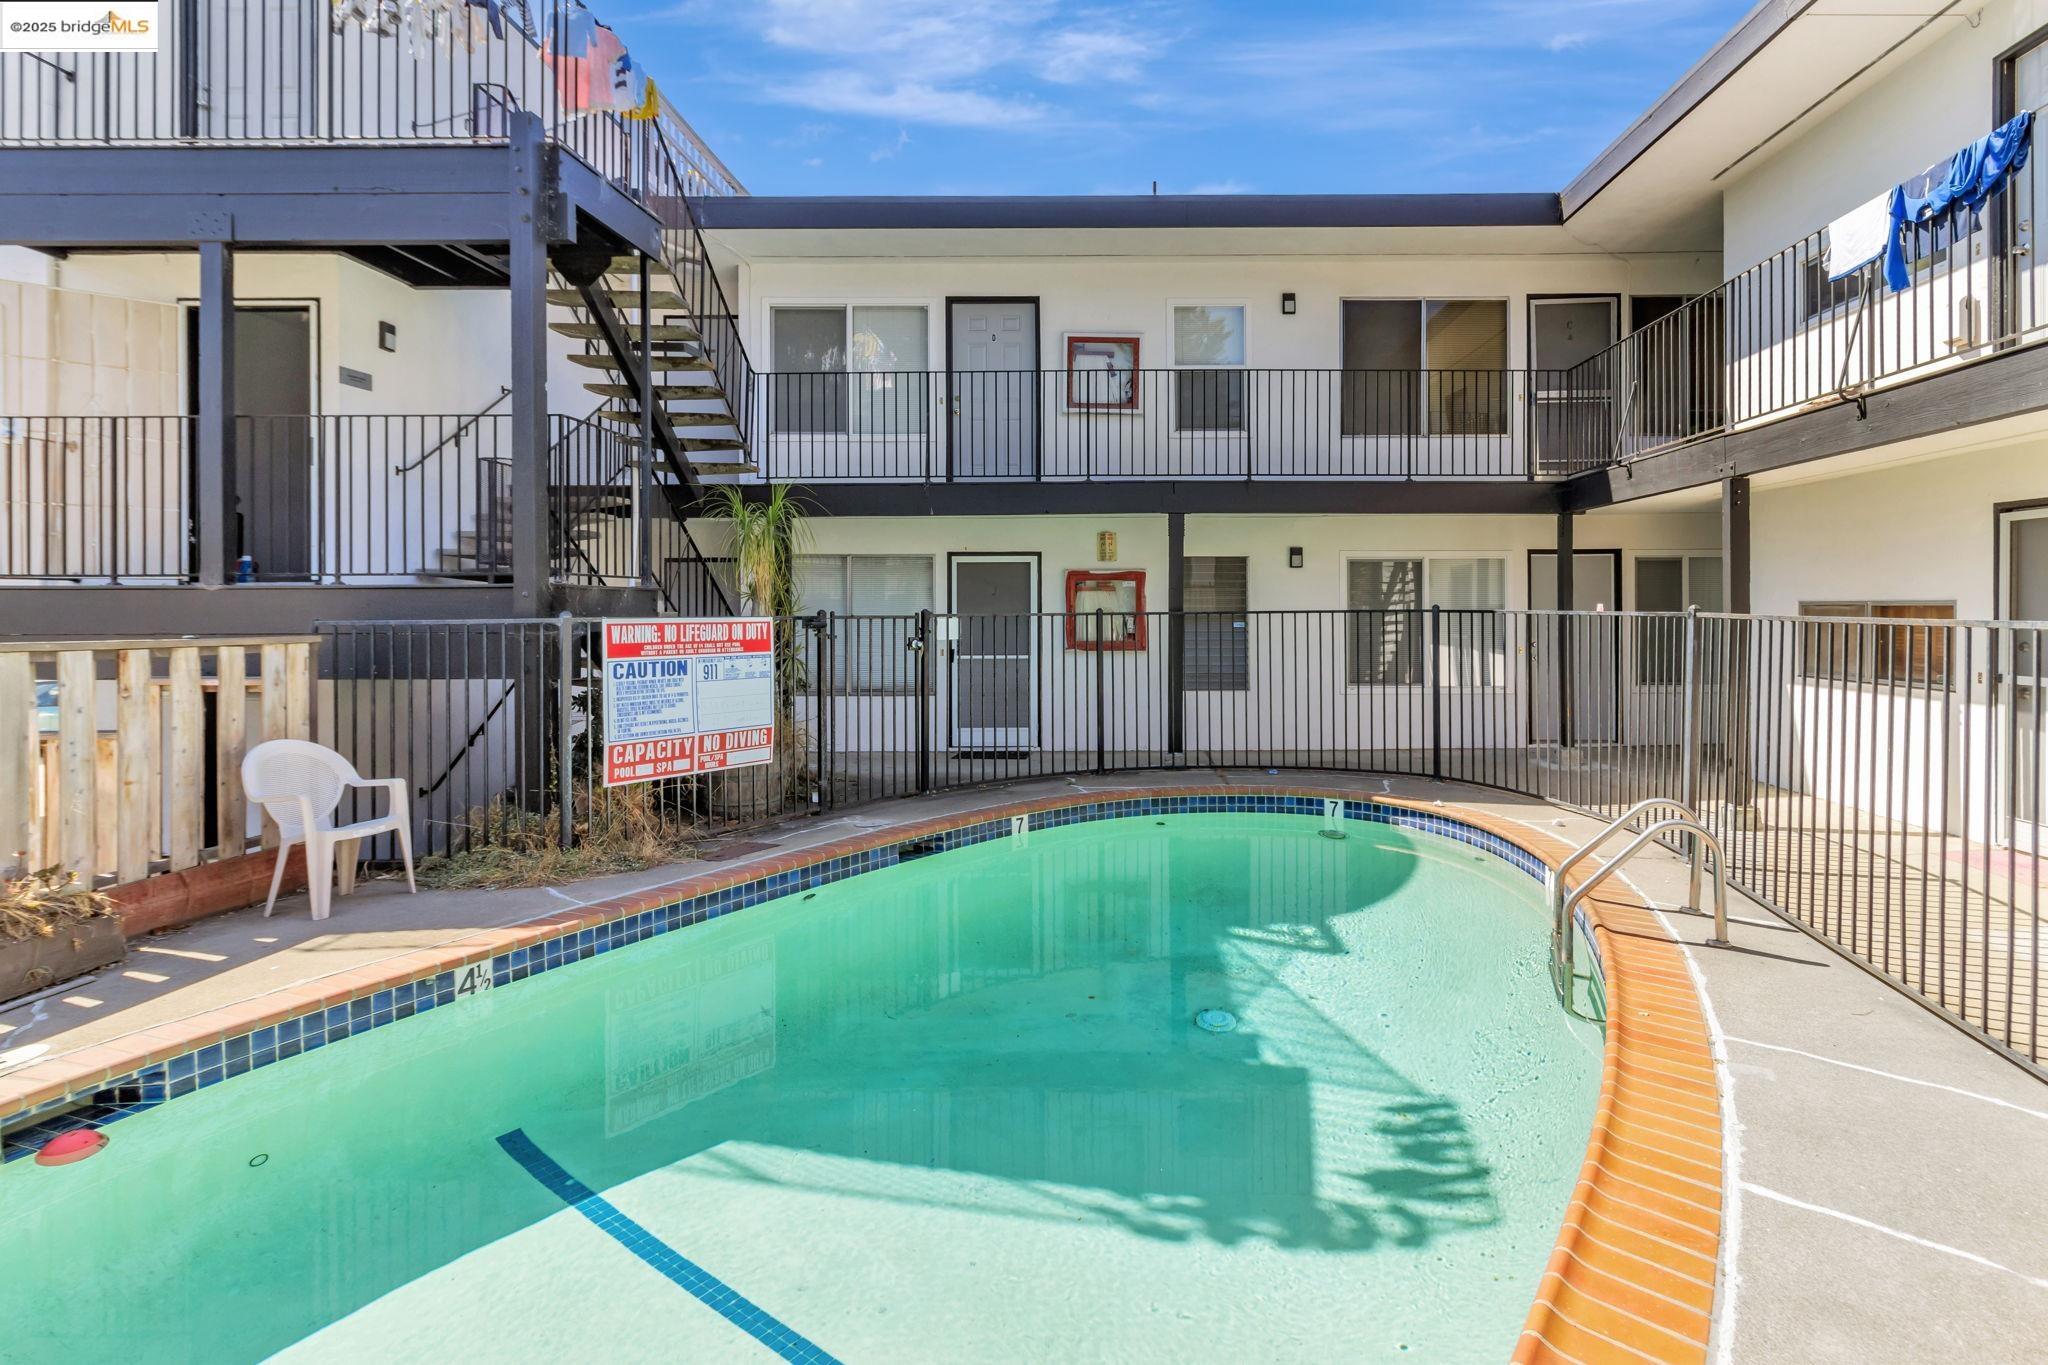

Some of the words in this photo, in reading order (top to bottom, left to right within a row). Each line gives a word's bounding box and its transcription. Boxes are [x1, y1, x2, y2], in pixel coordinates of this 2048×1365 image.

[611, 624, 661, 645] WARNING:
[664, 624, 677, 643] NO
[680, 623, 729, 642] LIFEGUARD
[731, 623, 743, 641] ON
[745, 622, 768, 640] DUTY
[613, 660, 688, 680] CAUTION
[703, 664, 718, 680] 911
[703, 734, 720, 752] NO
[726, 729, 767, 749] DIVING
[613, 738, 693, 764] CAPACITY
[614, 766, 635, 780] POOL
[656, 761, 672, 773] SPA
[1329, 801, 1339, 817] 7
[1015, 817, 1024, 834] 7
